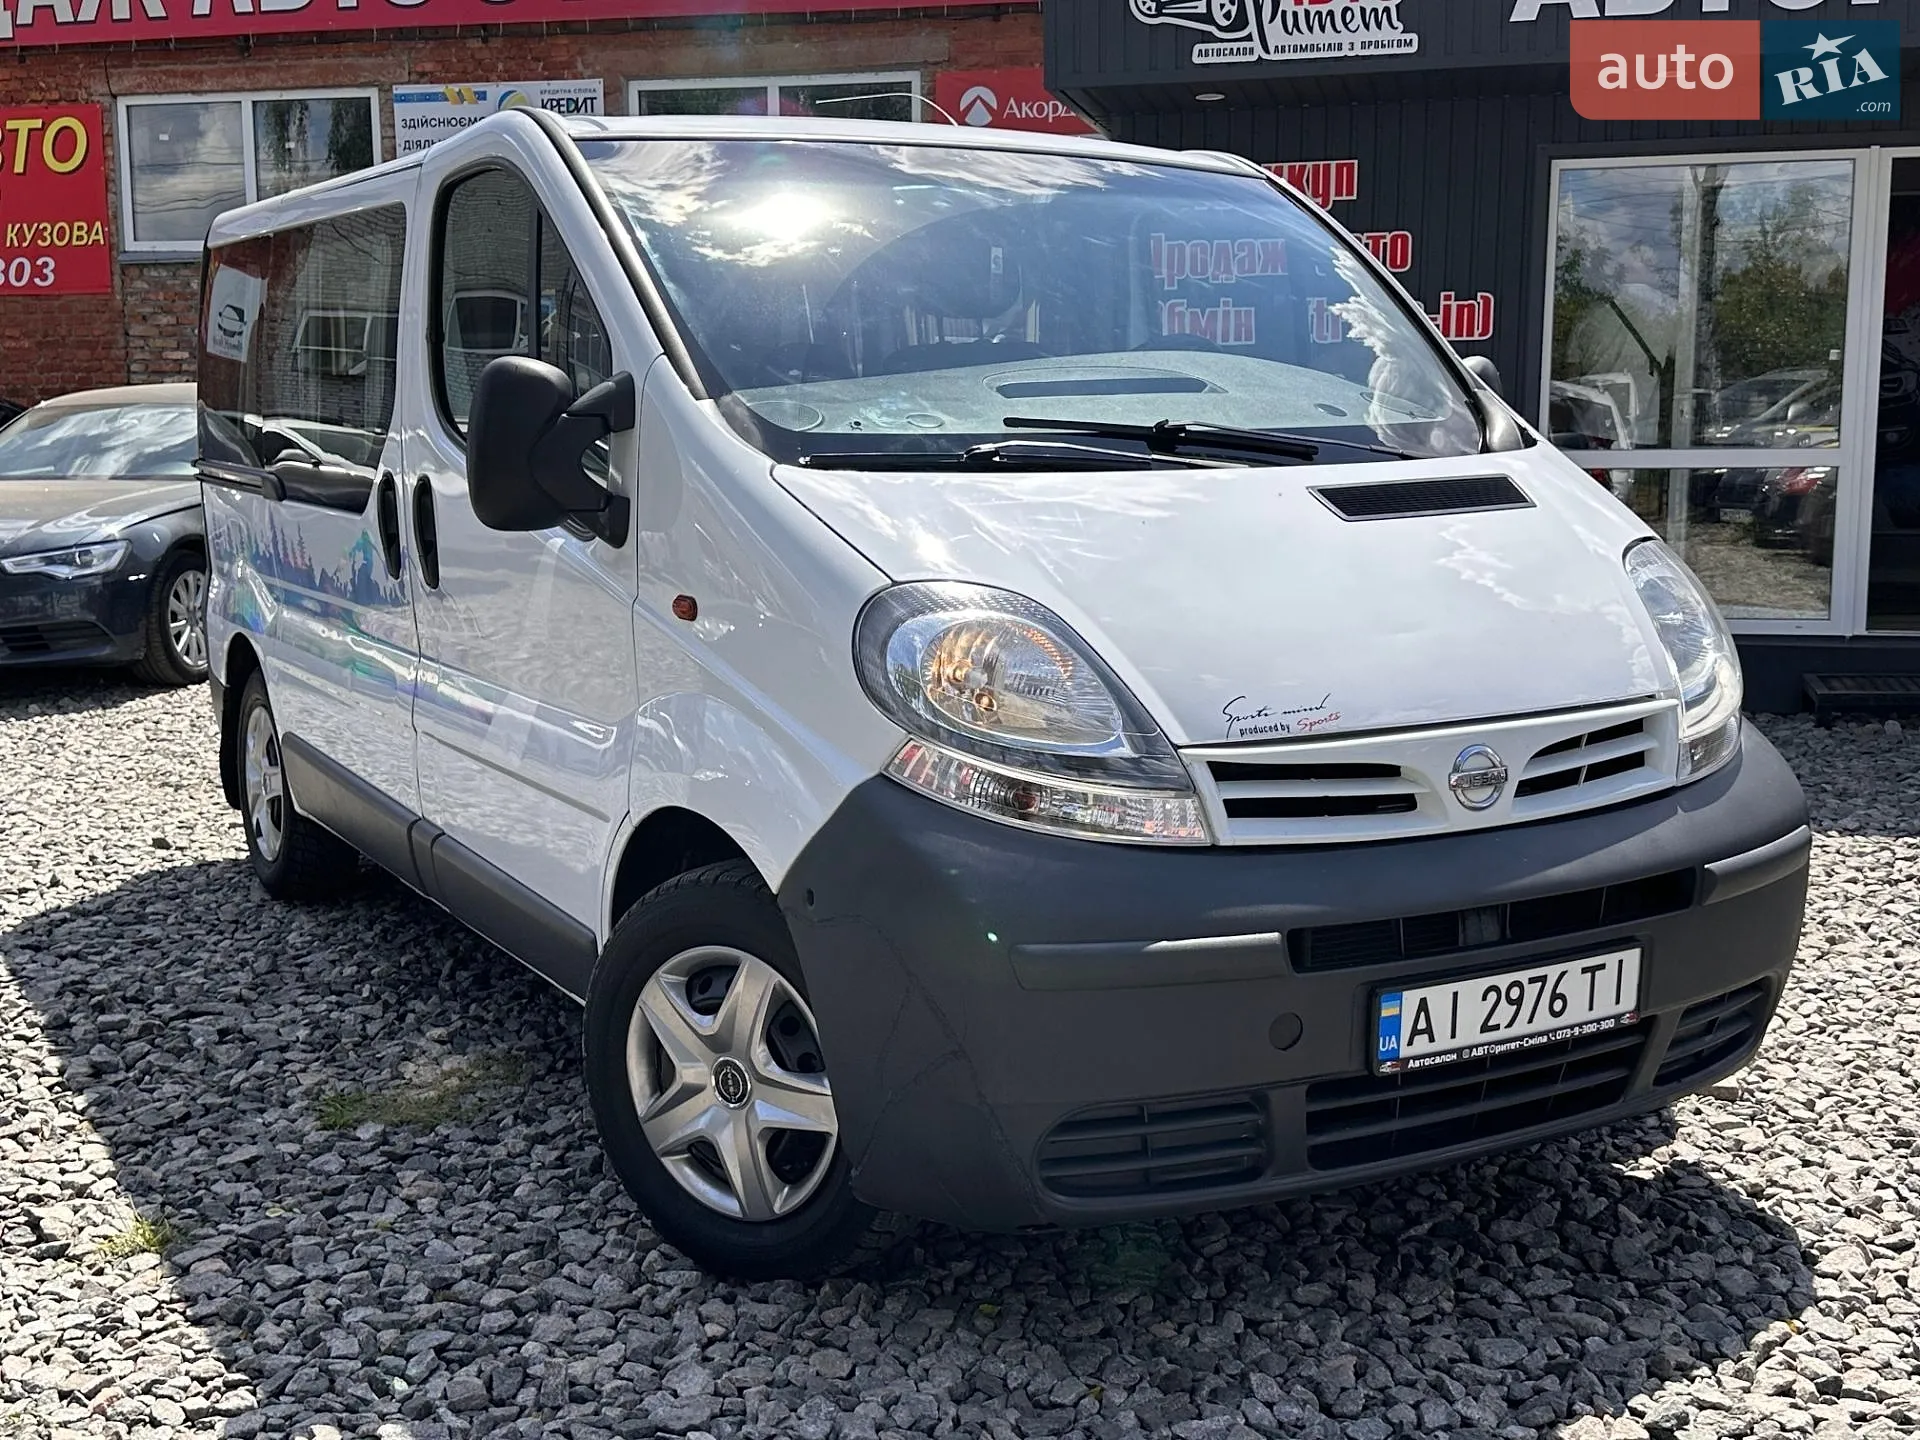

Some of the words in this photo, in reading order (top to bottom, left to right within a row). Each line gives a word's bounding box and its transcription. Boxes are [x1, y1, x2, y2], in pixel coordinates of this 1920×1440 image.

[1196, 46, 1255, 58] АВТОСАЛОН
[1273, 42, 1343, 55] АВТОМОБІЛІВ
[1360, 38, 1413, 50] ПРОБІГОМ
[0, 116, 87, 173] ТО
[6, 221, 105, 248] КУЗОВА
[0, 256, 56, 287] 03
[1159, 298, 1255, 344] бмін
[1239, 723, 1279, 738] produced
[1279, 722, 1291, 733] by
[1297, 711, 1342, 731] Sports
[1407, 991, 1459, 1047] AI
[1480, 969, 1568, 1034] 2976
[1581, 959, 1623, 1012] TI
[1379, 1035, 1398, 1051] UA
[1407, 1053, 1457, 1069] Автосалон
[1556, 1019, 1615, 1040] 073-9-300-300
